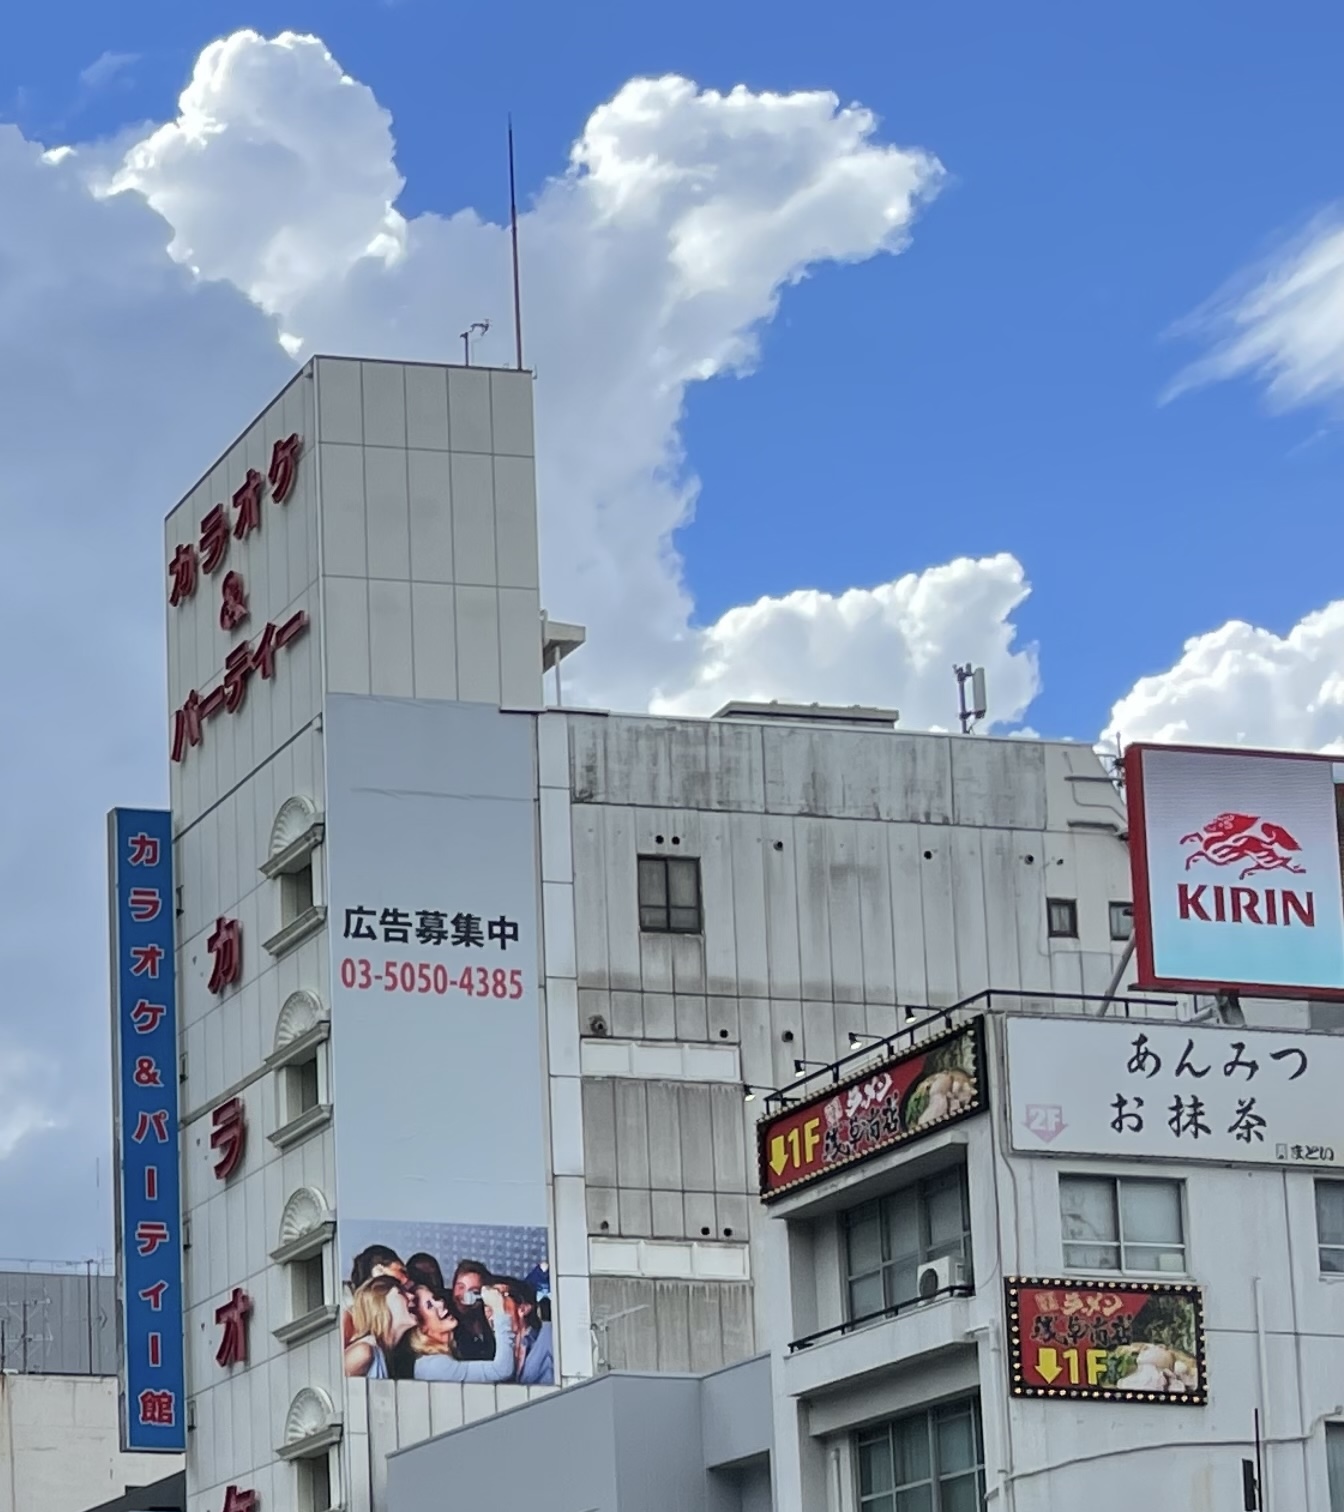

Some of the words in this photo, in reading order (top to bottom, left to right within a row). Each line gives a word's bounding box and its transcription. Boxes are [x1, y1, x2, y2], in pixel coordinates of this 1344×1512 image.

[169, 432, 304, 607] カラオケ
[220, 570, 250, 631] &
[170, 609, 310, 764] パーティー
[342, 906, 520, 951] 広告募集中
[1176, 883, 1316, 928] KIRIN
[340, 957, 524, 1001] 03-5050-4385
[1126, 1031, 1310, 1081] あんみつ
[787, 1117, 821, 1169] 1F
[1110, 1092, 1268, 1144] お抹茶
[1063, 1349, 1108, 1386] 1F
